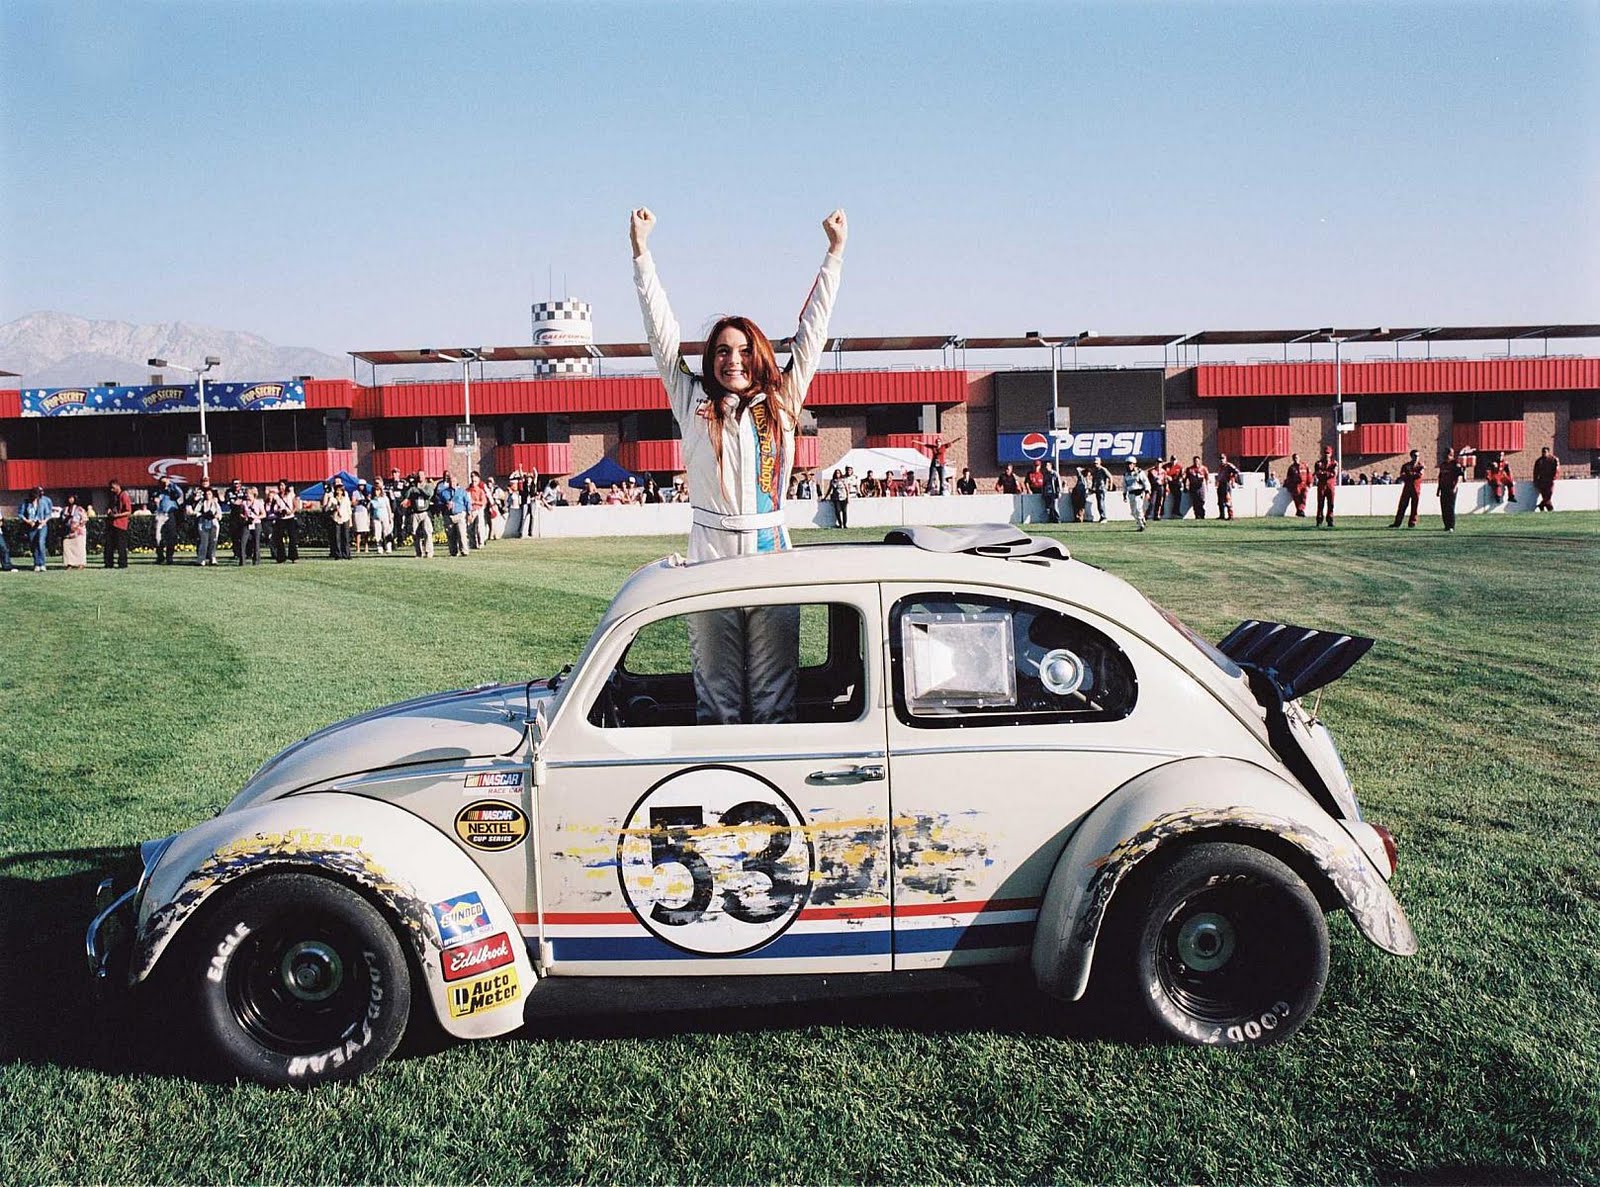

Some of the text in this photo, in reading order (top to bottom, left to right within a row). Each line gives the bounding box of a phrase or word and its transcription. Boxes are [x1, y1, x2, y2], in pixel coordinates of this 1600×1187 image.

[1051, 431, 1144, 457] PEPSI
[758, 456, 775, 493] Shops
[482, 774, 519, 786] NASCAR
[481, 810, 514, 820] NASCAR
[468, 823, 515, 834] NEXTEL
[649, 800, 793, 927] 53
[442, 904, 483, 927] SUNOCO
[206, 921, 251, 983] EAGLE
[450, 940, 509, 972] Edelbrock
[472, 974, 509, 996] Auto
[468, 983, 518, 1014] Meter
